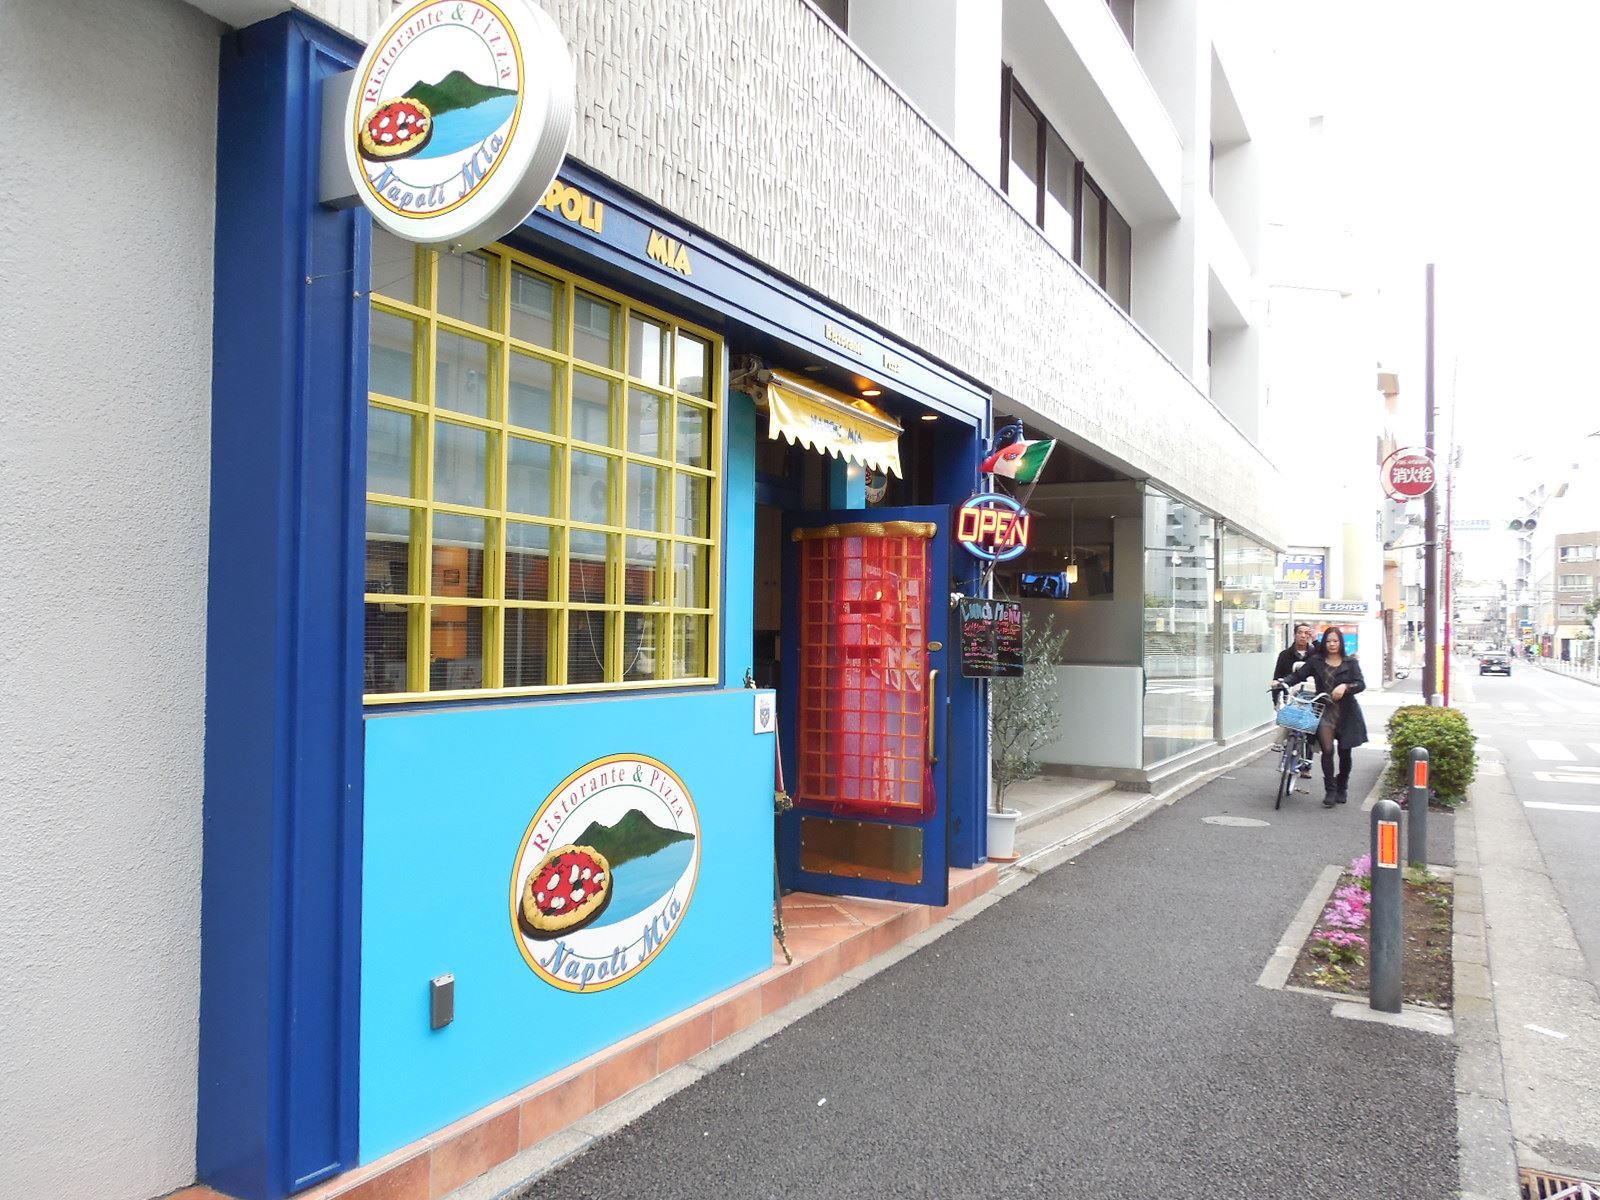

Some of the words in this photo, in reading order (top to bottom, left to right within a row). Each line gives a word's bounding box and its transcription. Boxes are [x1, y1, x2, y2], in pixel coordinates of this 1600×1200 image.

[365, 9, 443, 103] Ristorante
[451, 3, 464, 21] &
[471, 8, 512, 80] Pizza
[368, 166, 446, 211] Napoli
[459, 134, 503, 199] Mia
[647, 229, 693, 275] MIA
[1392, 466, 1433, 484] 消火栓
[958, 507, 1030, 547] OPEN
[533, 766, 625, 852] Ristorante
[632, 764, 643, 783] &
[650, 769, 684, 819] Pizza
[540, 941, 628, 990] Napoli
[639, 898, 681, 963] Mia
